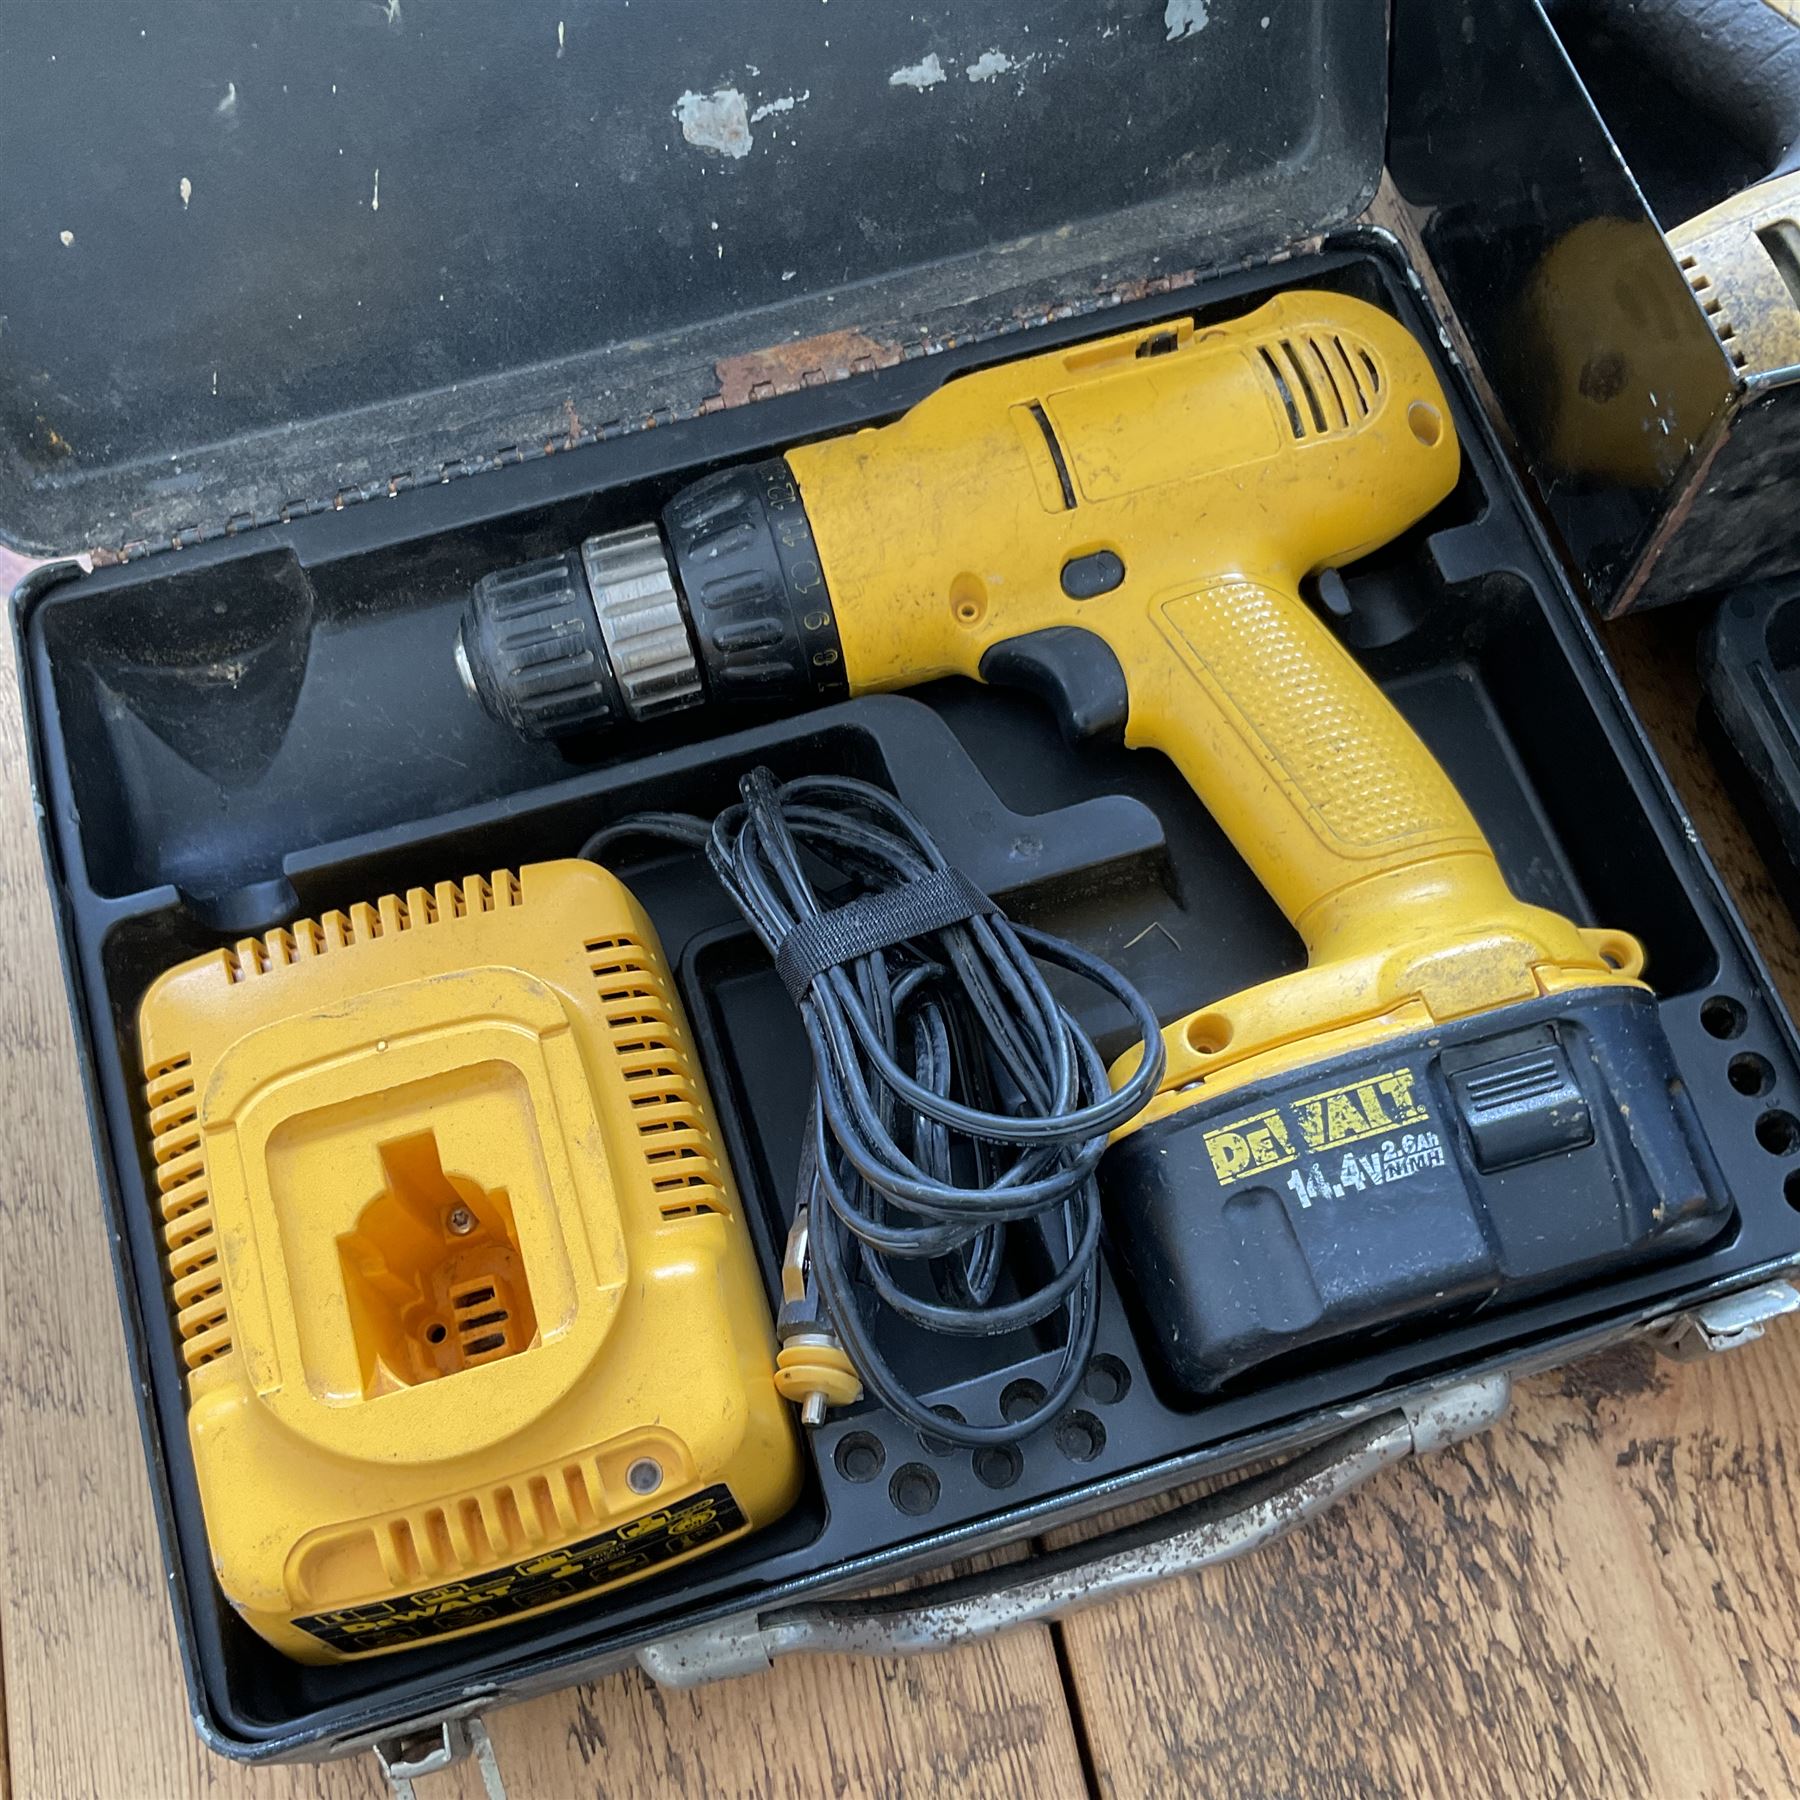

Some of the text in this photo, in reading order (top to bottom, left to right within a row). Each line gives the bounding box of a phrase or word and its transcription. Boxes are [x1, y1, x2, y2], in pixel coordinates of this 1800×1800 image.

[767, 482, 797, 510] 12
[778, 519, 808, 547] 11
[791, 561, 821, 593] 10
[804, 611, 830, 630] 9
[813, 649, 838, 666] 8
[1381, 1131, 1439, 1162] 2.6Ah
[1286, 1152, 1383, 1208] 14.4V
